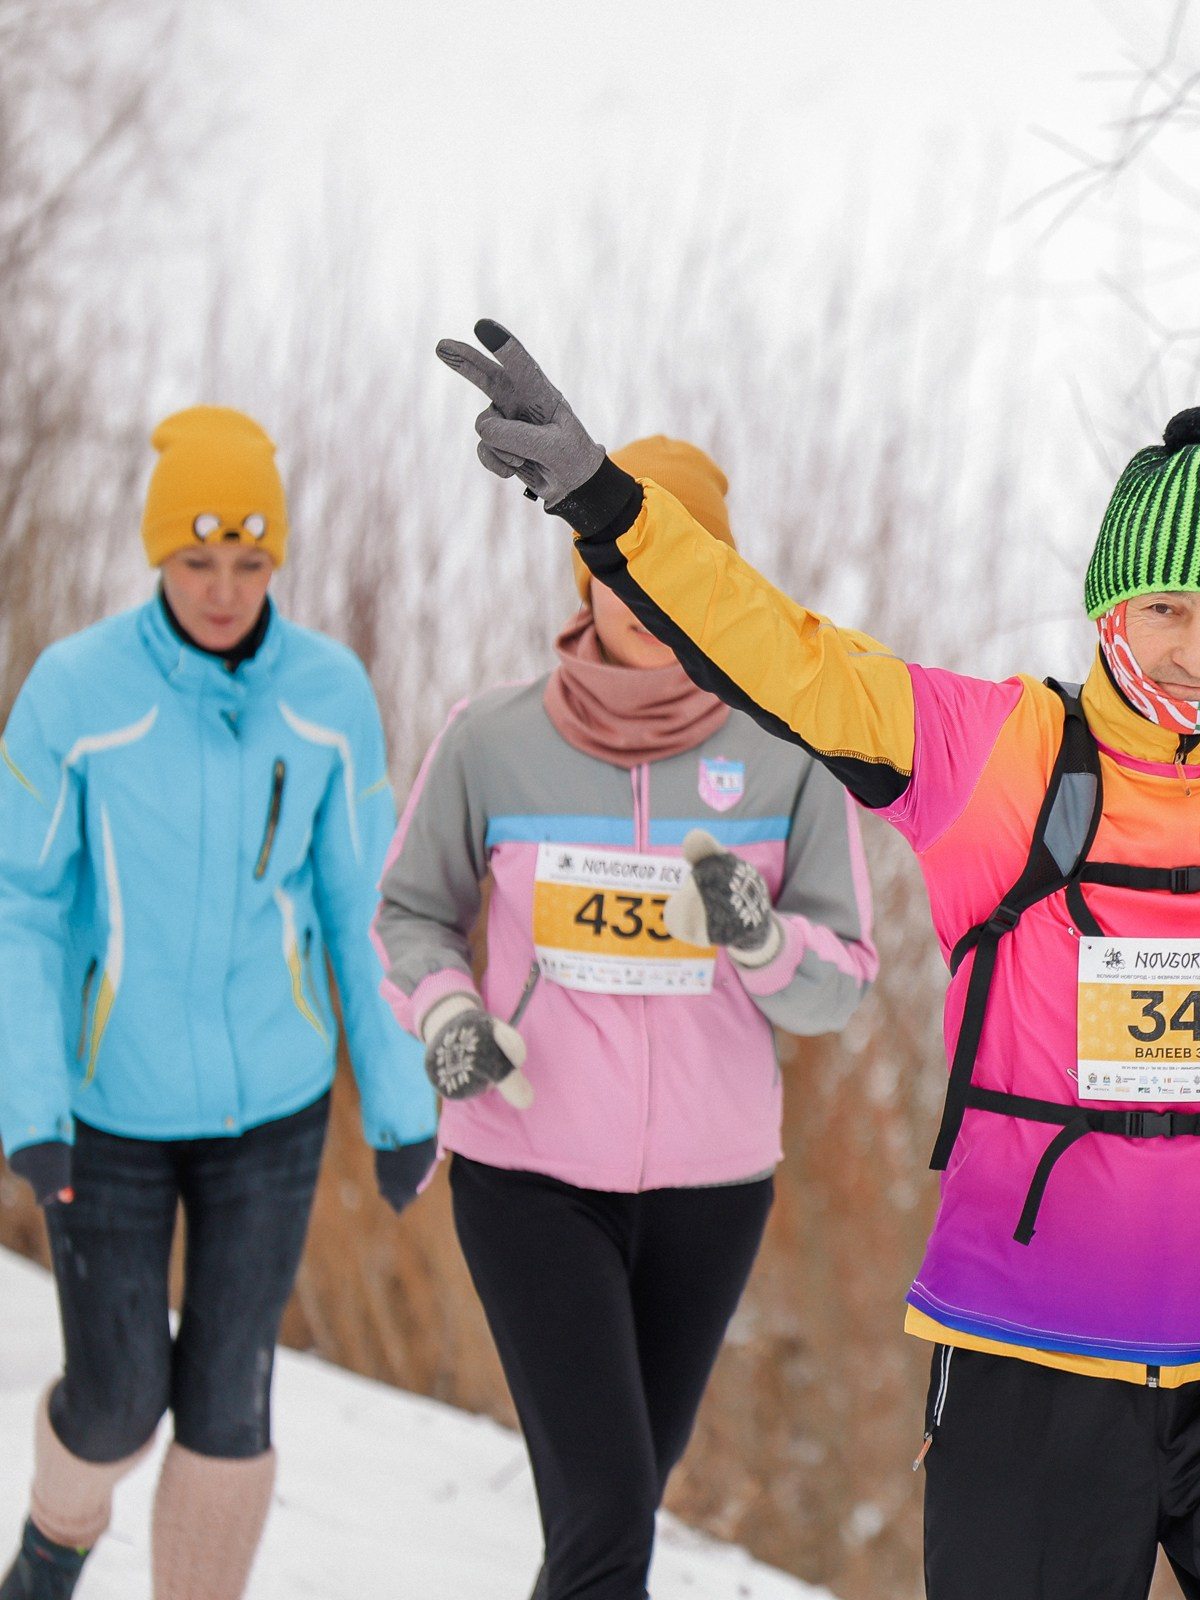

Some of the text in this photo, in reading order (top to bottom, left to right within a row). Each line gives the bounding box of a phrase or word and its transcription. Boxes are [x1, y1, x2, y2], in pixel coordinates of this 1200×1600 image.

[582, 859, 682, 883] NOVGOROD ICE
[576, 894, 672, 941] 433
[1135, 1047, 1192, 1059] ВАЛЕЕВ
